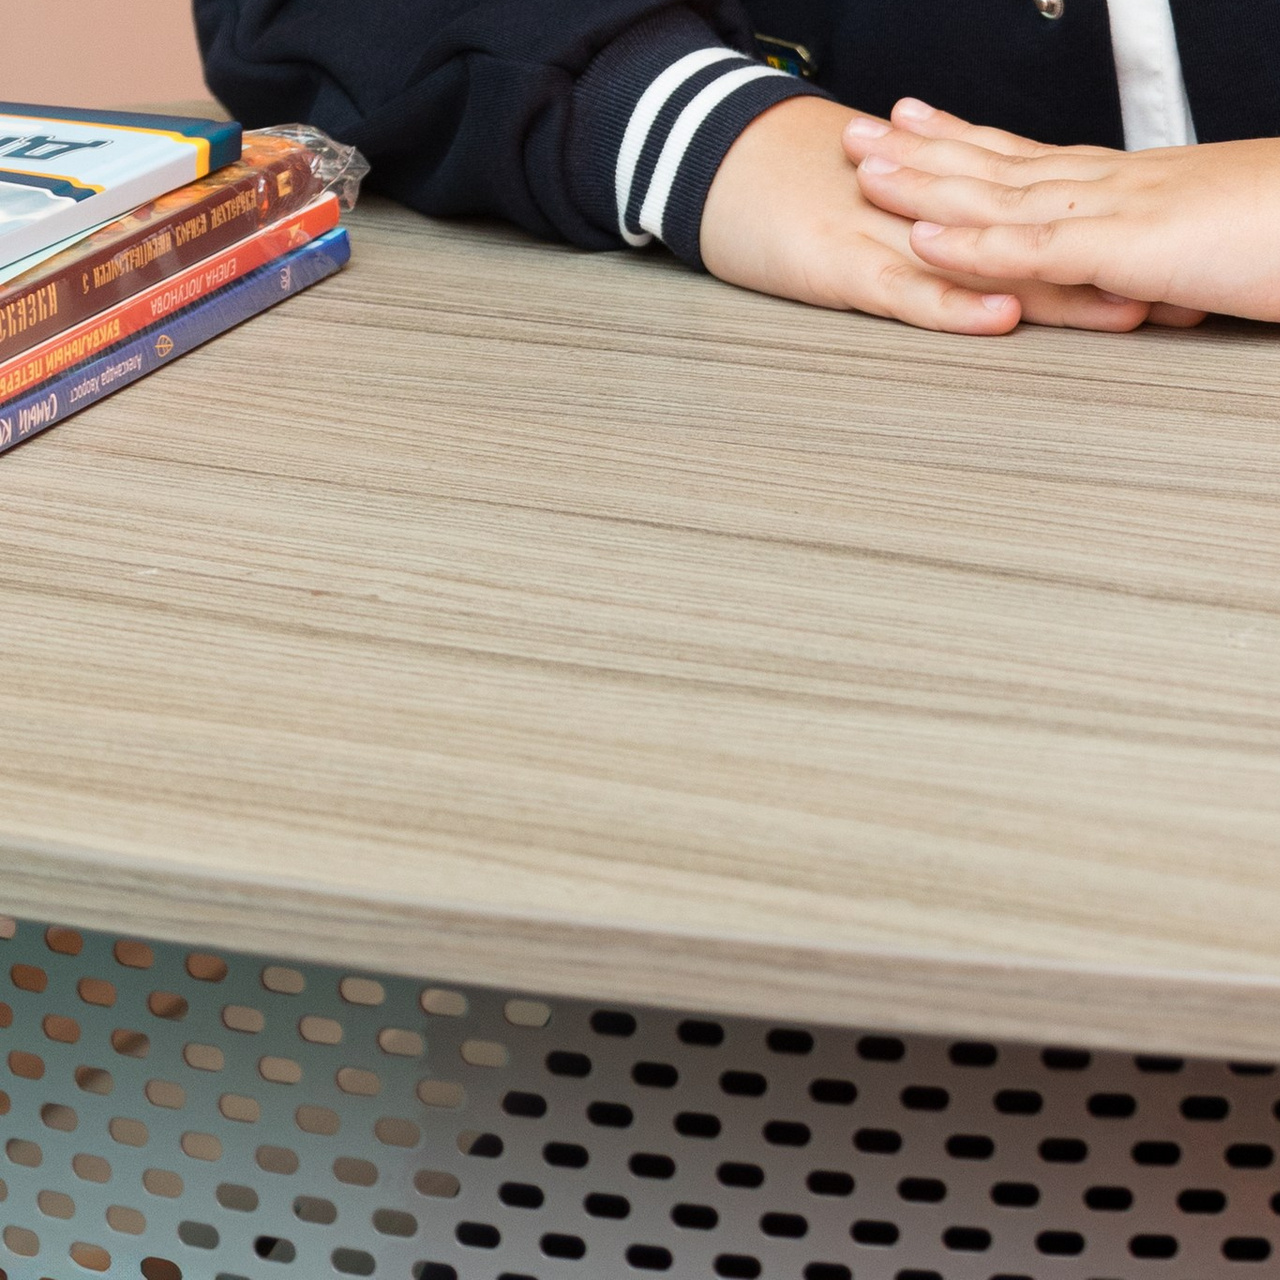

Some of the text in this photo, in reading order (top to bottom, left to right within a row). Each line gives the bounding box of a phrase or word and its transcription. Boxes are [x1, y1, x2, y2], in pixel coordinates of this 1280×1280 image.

[175, 213, 207, 247] БОРИСА
[204, 258, 236, 289] ЕЛЕНА
[0, 282, 58, 341] СКАЗКИ
[150, 276, 203, 317] ЛОГУНОВА
[45, 318, 120, 378] БУКВАЛЬНЫЙ
[69, 353, 143, 403] Александра Хворост
